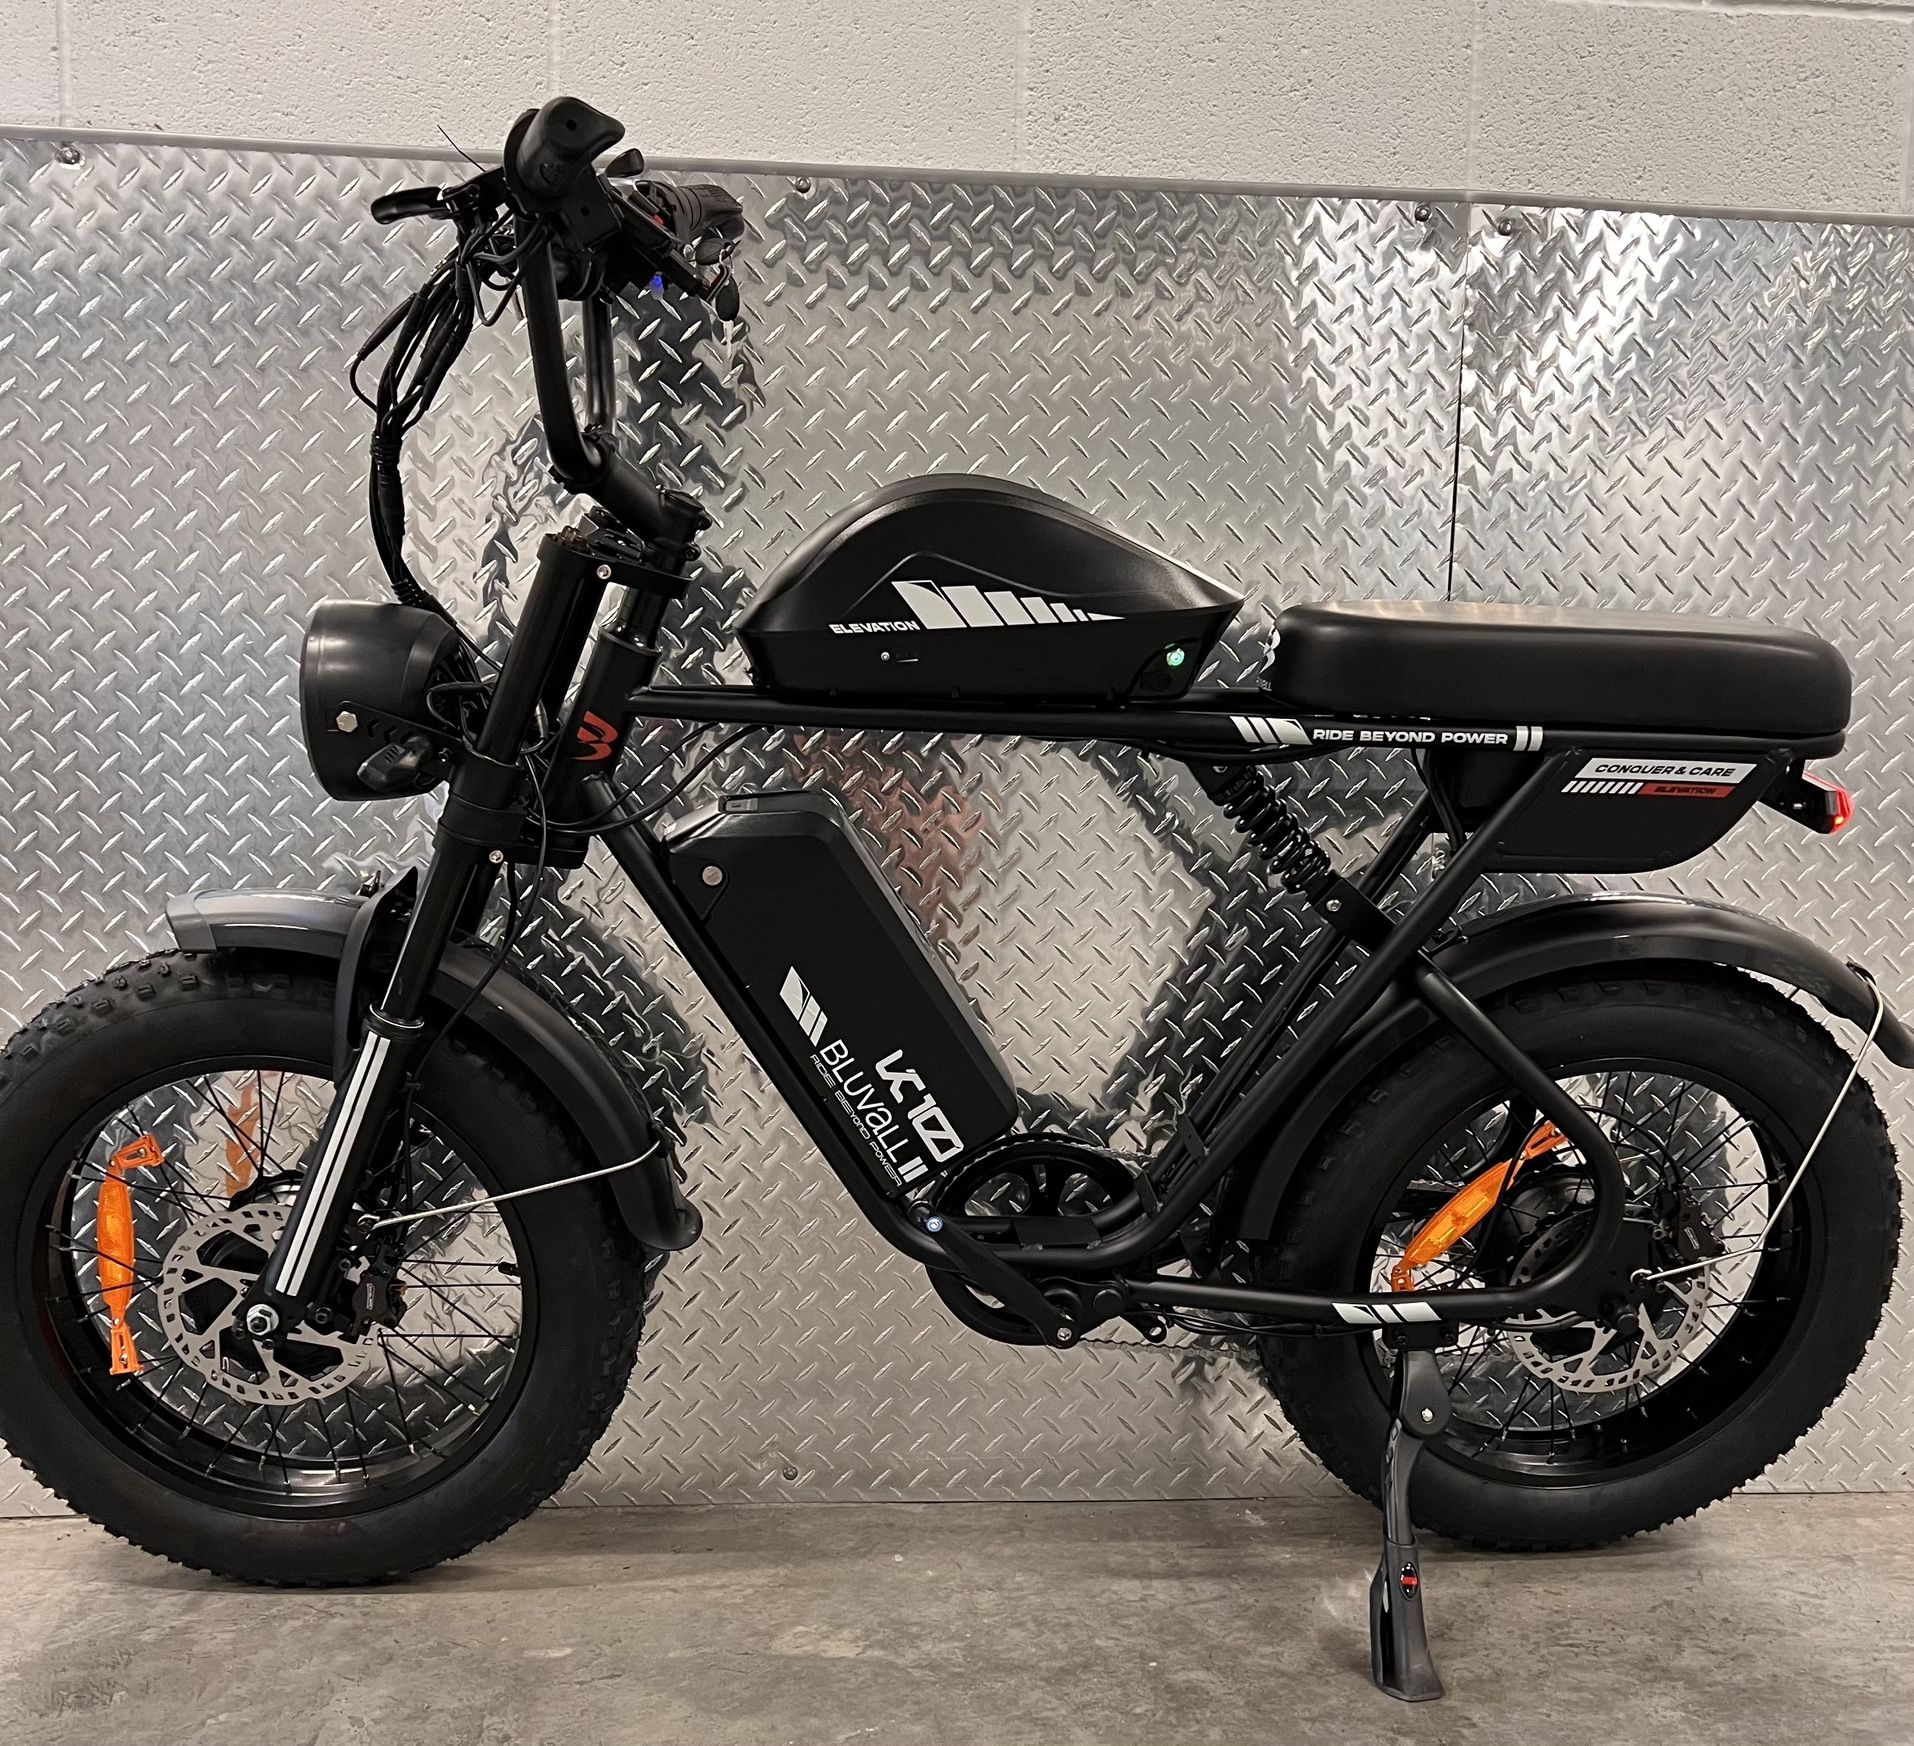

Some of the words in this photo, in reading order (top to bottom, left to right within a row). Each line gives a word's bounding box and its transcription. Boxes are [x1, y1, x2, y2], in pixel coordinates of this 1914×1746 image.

[829, 621, 921, 634] ELEVATION
[1313, 728, 1354, 741] RIDE
[1359, 730, 1436, 743] BEYOND
[1441, 731, 1509, 745] POWER
[1594, 764, 1675, 775] CONQUER
[1674, 766, 1686, 775] &
[1688, 767, 1736, 777] CARE
[809, 1053, 835, 1089] RIDE
